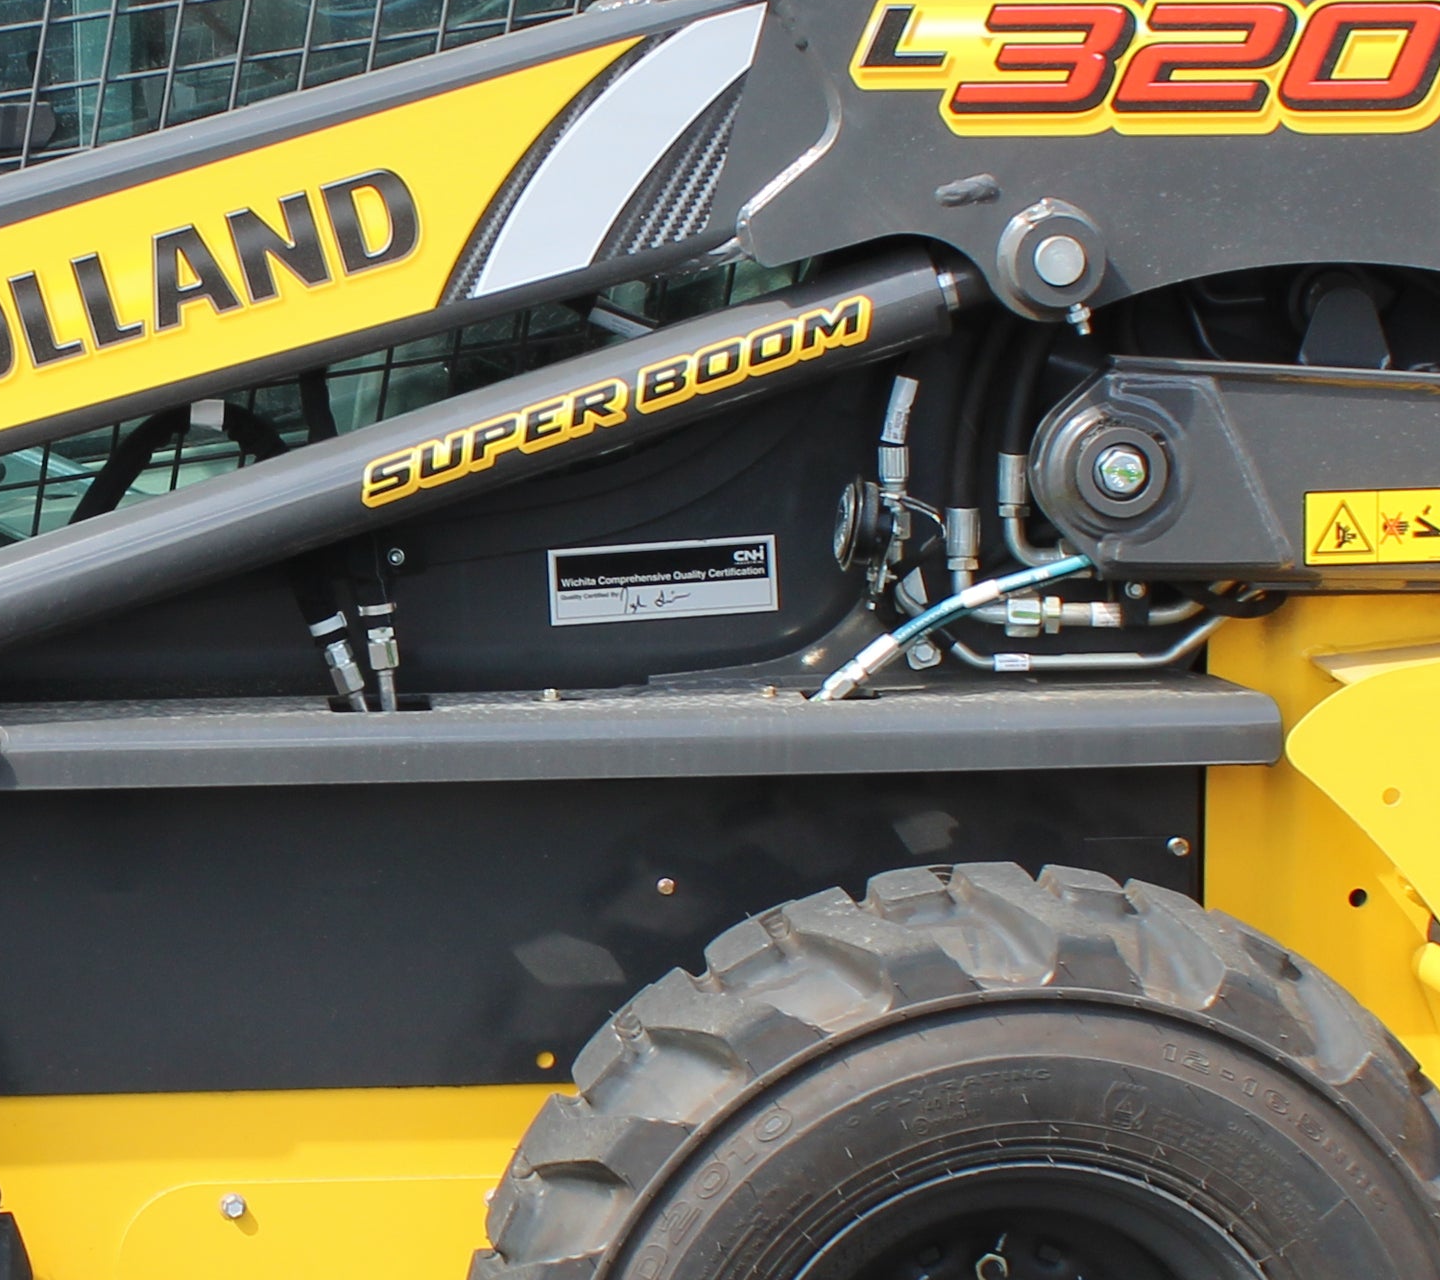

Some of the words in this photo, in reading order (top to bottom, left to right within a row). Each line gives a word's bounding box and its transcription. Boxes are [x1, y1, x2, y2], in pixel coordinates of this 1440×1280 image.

[365, 380, 627, 504] SUPER
[638, 297, 867, 409] BOOM
[560, 576, 597, 588] Wichita
[598, 570, 672, 586] Comprehensive
[673, 568, 707, 582] Quality
[708, 566, 766, 578] Certification
